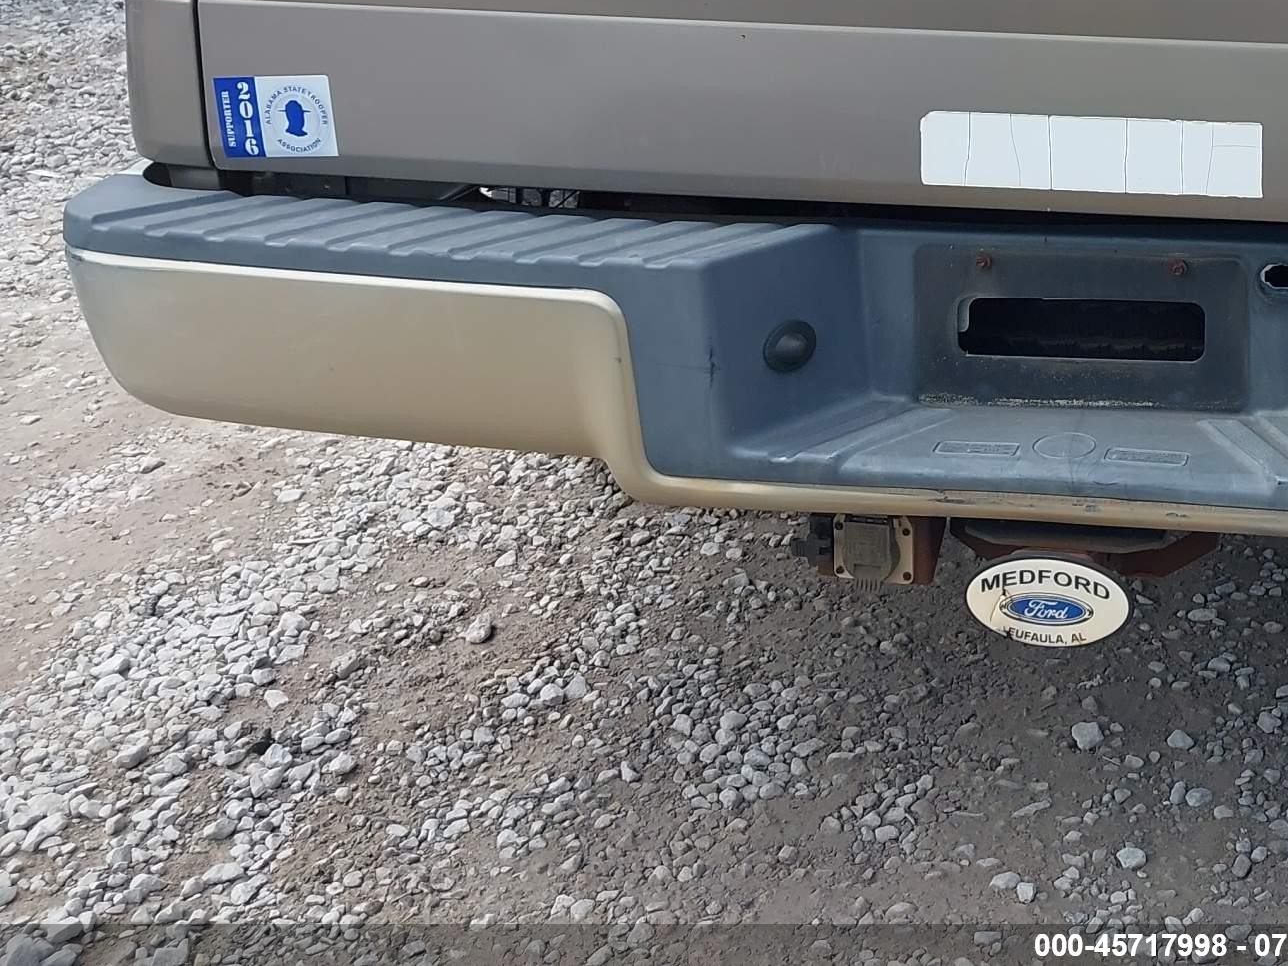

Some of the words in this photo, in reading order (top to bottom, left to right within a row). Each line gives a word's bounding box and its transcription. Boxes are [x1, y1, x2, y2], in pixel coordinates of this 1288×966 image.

[221, 90, 237, 148] SUPPORTER
[237, 81, 260, 156] 2016
[265, 90, 283, 125] ALABAMA
[283, 85, 306, 94] STATE
[307, 90, 329, 125] TROOPER
[277, 137, 322, 153] ASSOCIATION
[981, 569, 1111, 600] MEDFORD
[1024, 599, 1069, 620] Ford
[1071, 632, 1088, 643] AL
